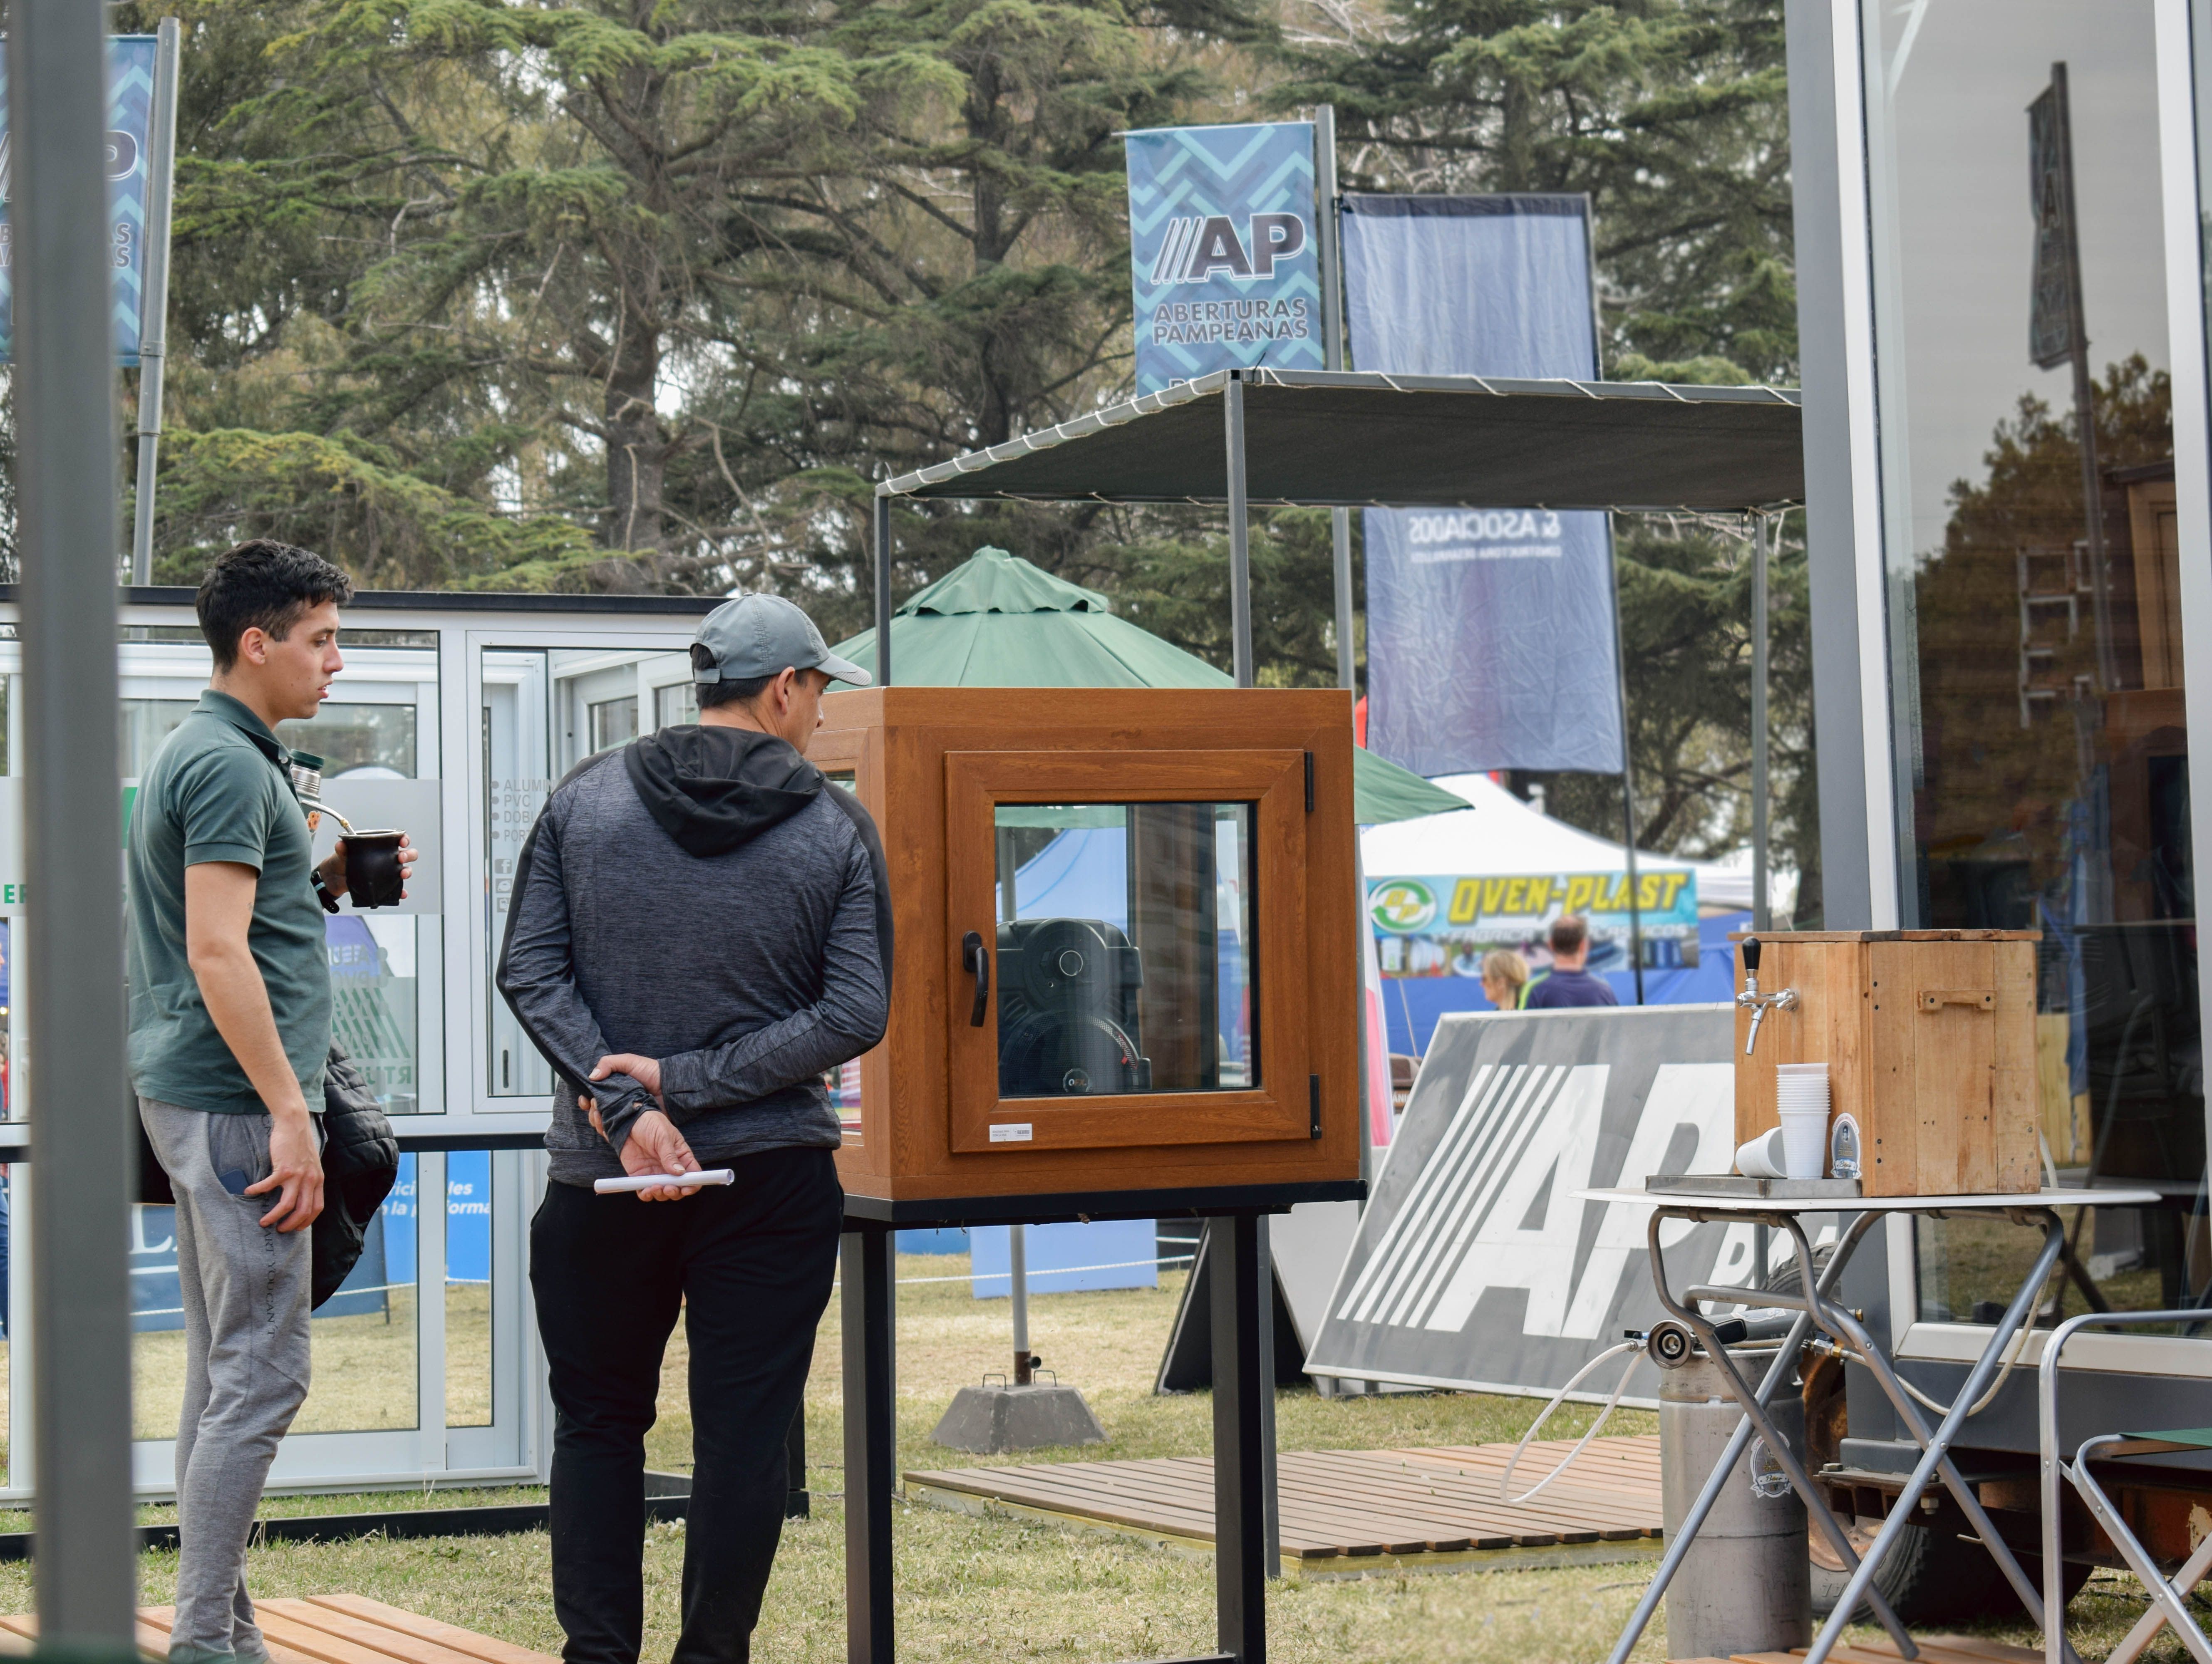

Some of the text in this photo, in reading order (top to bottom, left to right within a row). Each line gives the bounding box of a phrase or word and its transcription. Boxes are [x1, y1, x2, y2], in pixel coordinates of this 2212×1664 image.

[1152, 297, 1307, 324] ABERTURAS
[1152, 319, 1309, 346] PAMPEANAS
[503, 779, 558, 792] ALUMIN
[503, 795, 531, 807] PVC
[504, 810, 537, 823] DOBL
[1448, 874, 1688, 924] OVEN-PLAST
